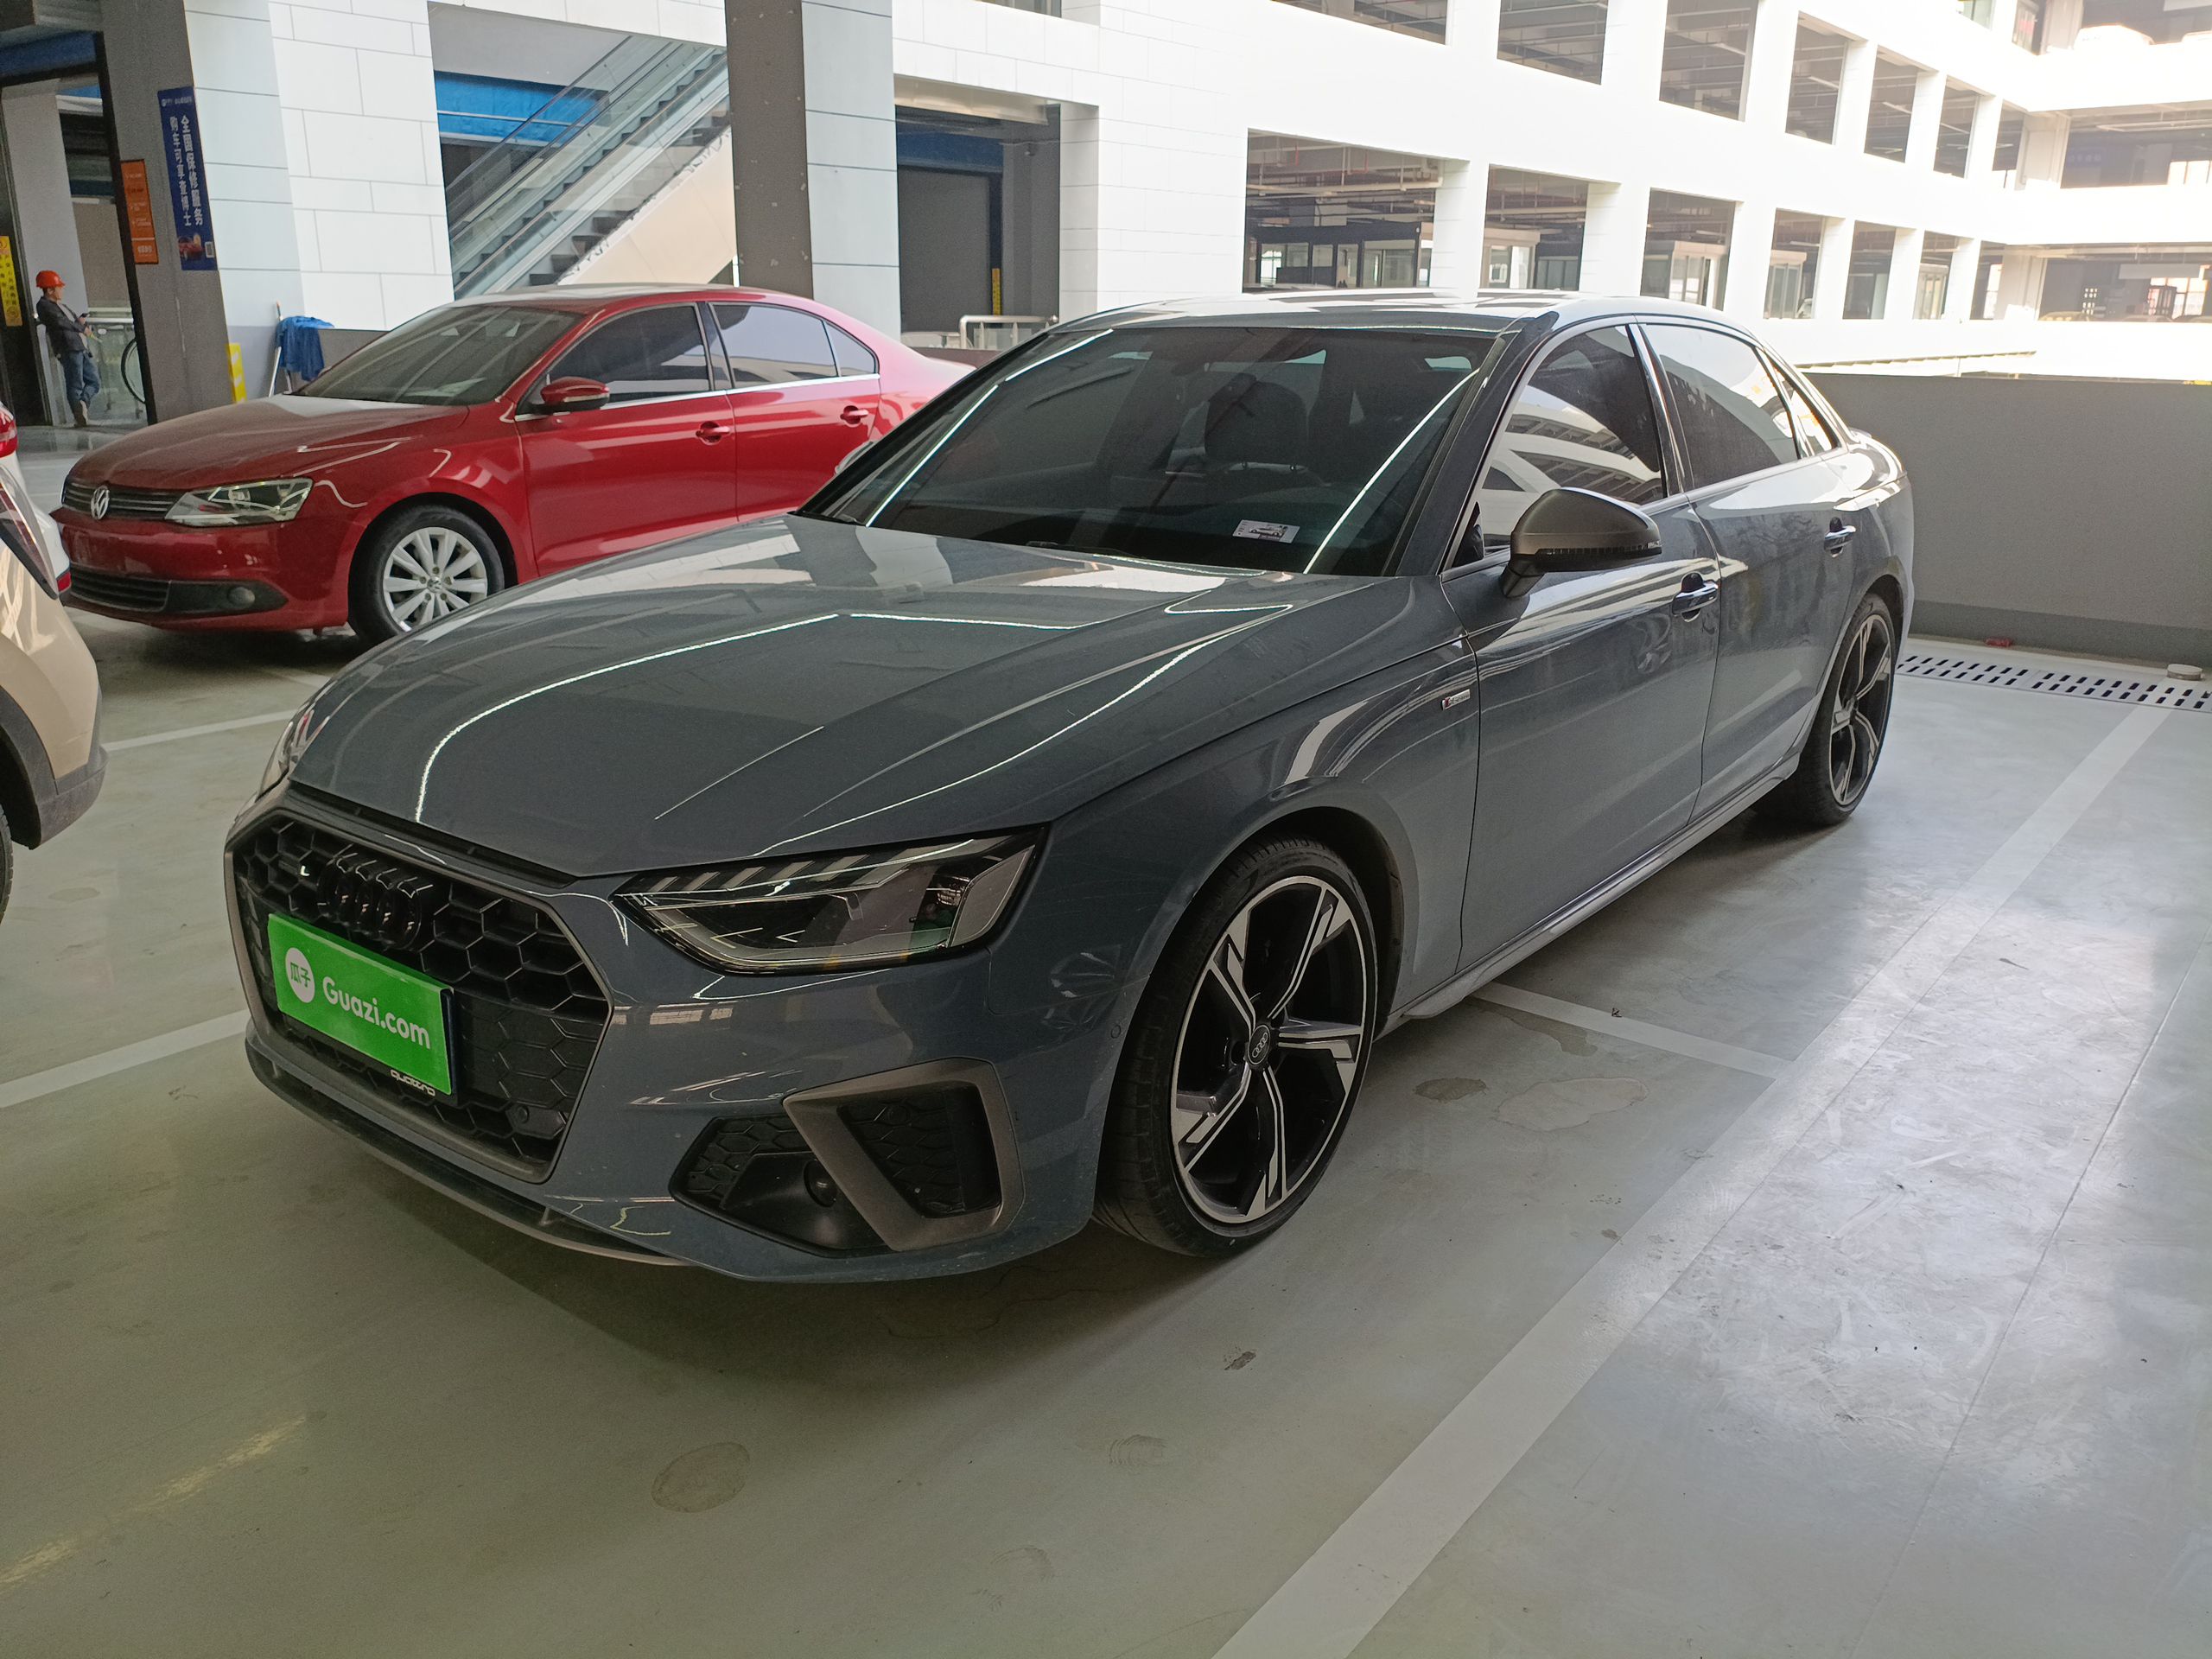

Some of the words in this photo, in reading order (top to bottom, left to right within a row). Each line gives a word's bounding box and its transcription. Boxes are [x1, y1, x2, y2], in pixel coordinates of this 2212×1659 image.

[181, 115, 204, 226] 全国保修服务
[289, 961, 312, 989] 瓜子
[322, 976, 431, 1050] Guazi.com
[390, 1069, 435, 1096] quattro
